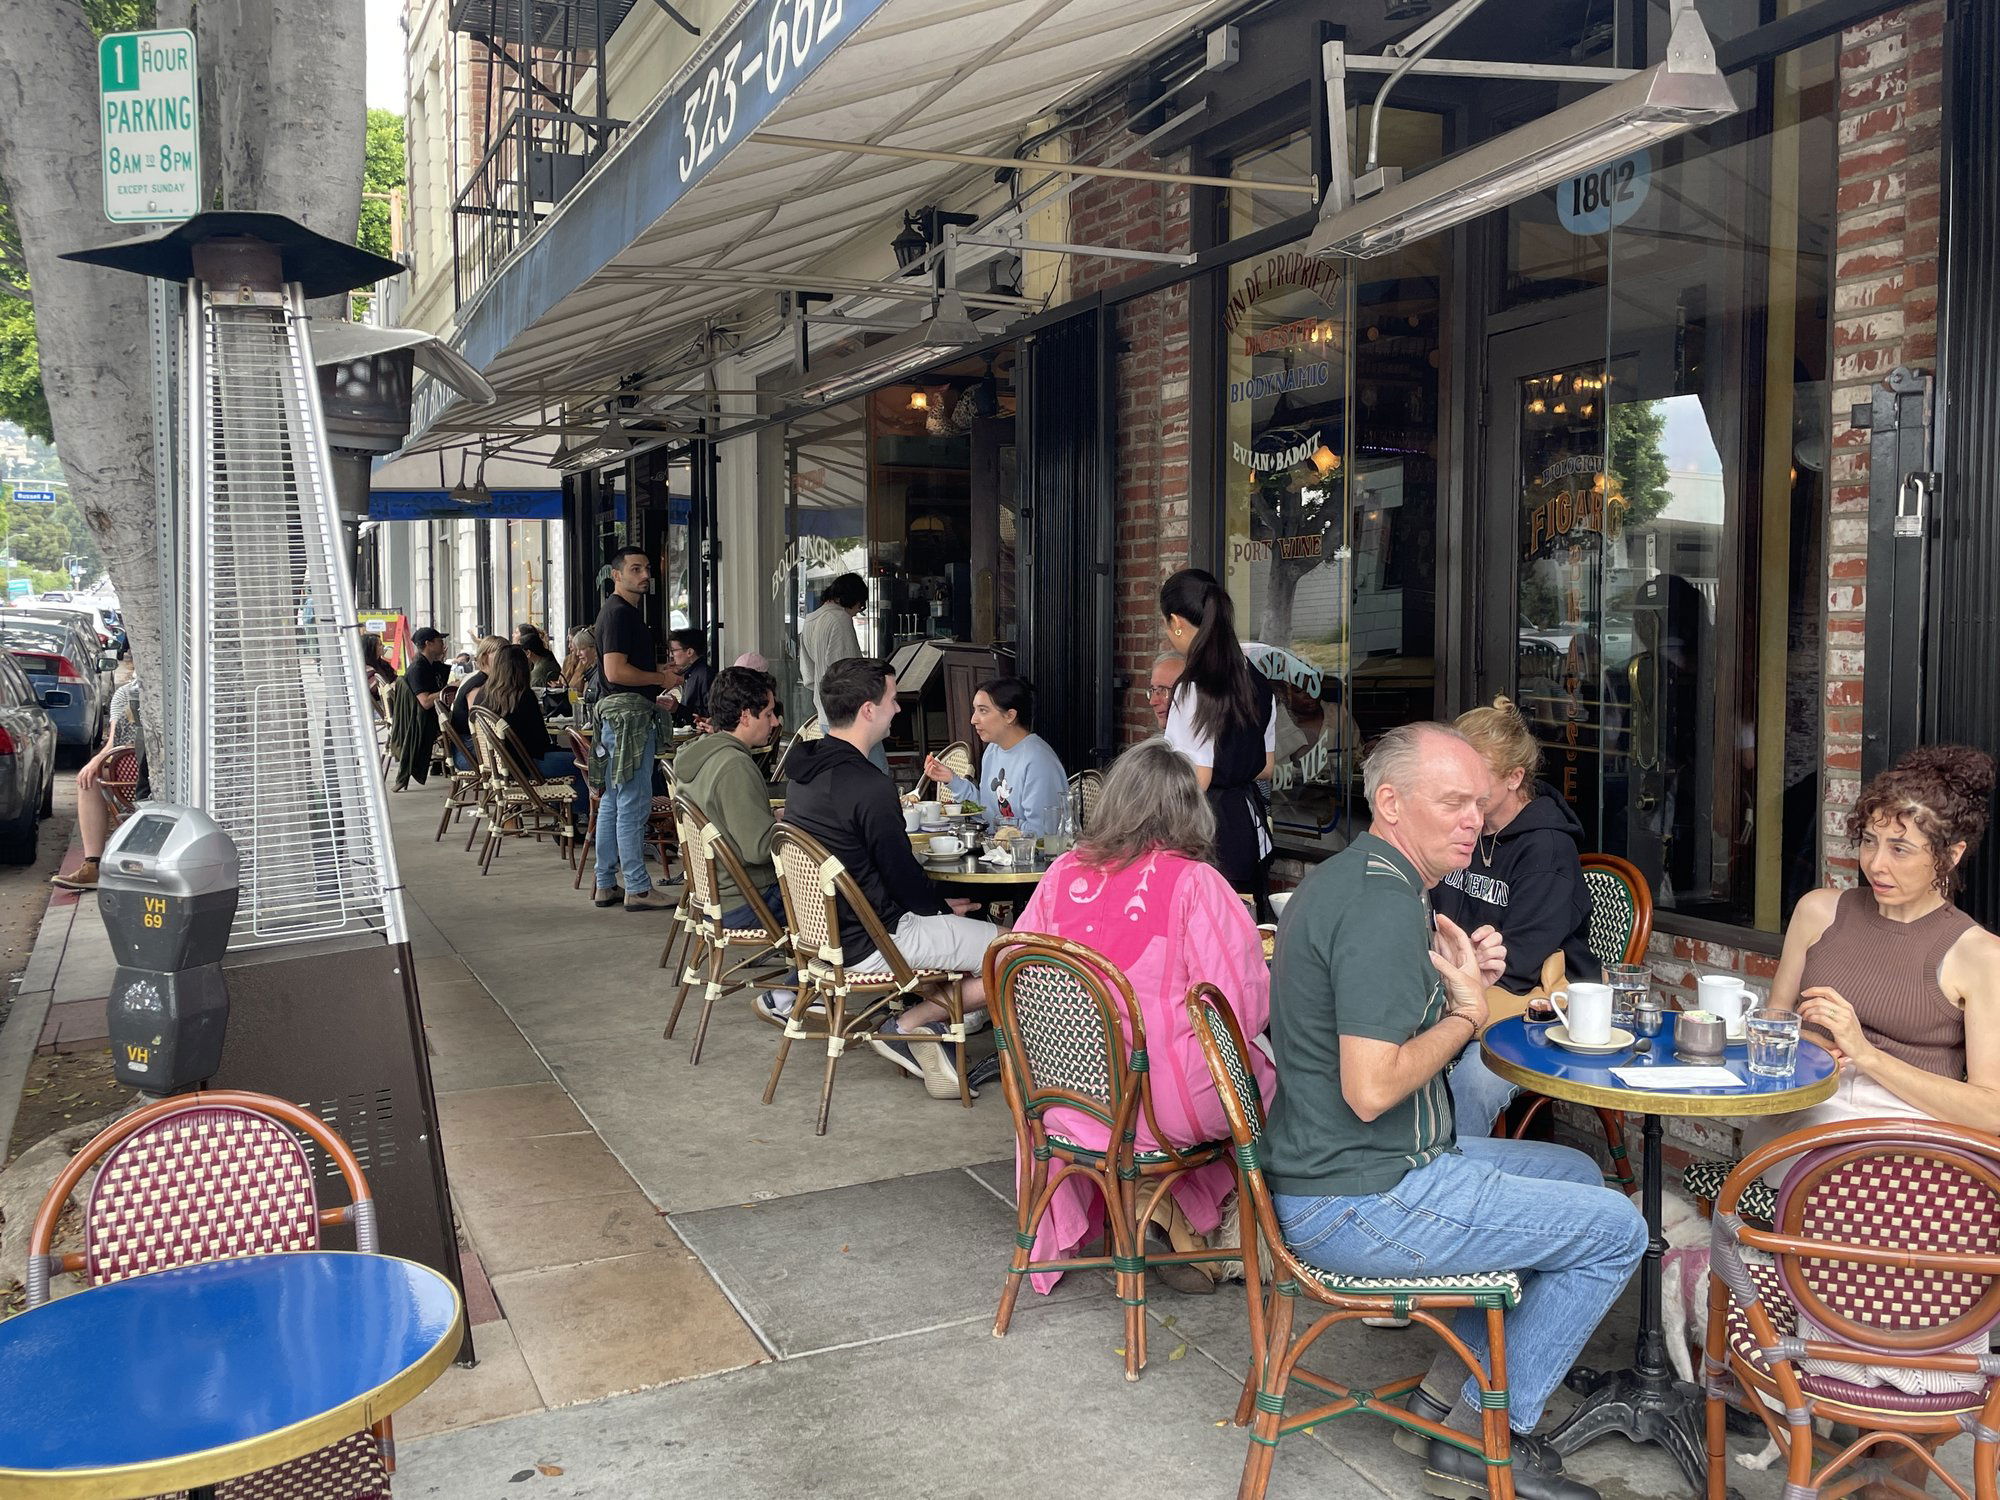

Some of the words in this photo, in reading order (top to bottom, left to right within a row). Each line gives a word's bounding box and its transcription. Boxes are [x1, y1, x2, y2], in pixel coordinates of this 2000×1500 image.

[114, 44, 125, 84] 1
[141, 47, 188, 73] HOUR
[106, 95, 191, 134] PARKING
[109, 146, 142, 175] 8AM
[160, 144, 192, 173] 8PM
[117, 184, 148, 195] EXCEPT
[151, 182, 186, 193] SUNDAY
[1572, 160, 1635, 217] 1802
[1222, 289, 1247, 336] VIN
[1245, 265, 1264, 305] DE
[1230, 361, 1329, 404] BIODYNAMIC
[1232, 441, 1270, 472] EVIAN
[1275, 430, 1321, 471] BADOIT
[1541, 454, 1605, 489] BIOLOGIQU
[1530, 489, 1624, 555] FIGARO
[1233, 540, 1273, 563] PORT
[1277, 534, 1322, 560] WINE
[1272, 762, 1293, 792] DE
[1299, 728, 1329, 784] VIE
[143, 913, 163, 929] 69
[144, 896, 166, 914] VH
[127, 1046, 148, 1064] VH
